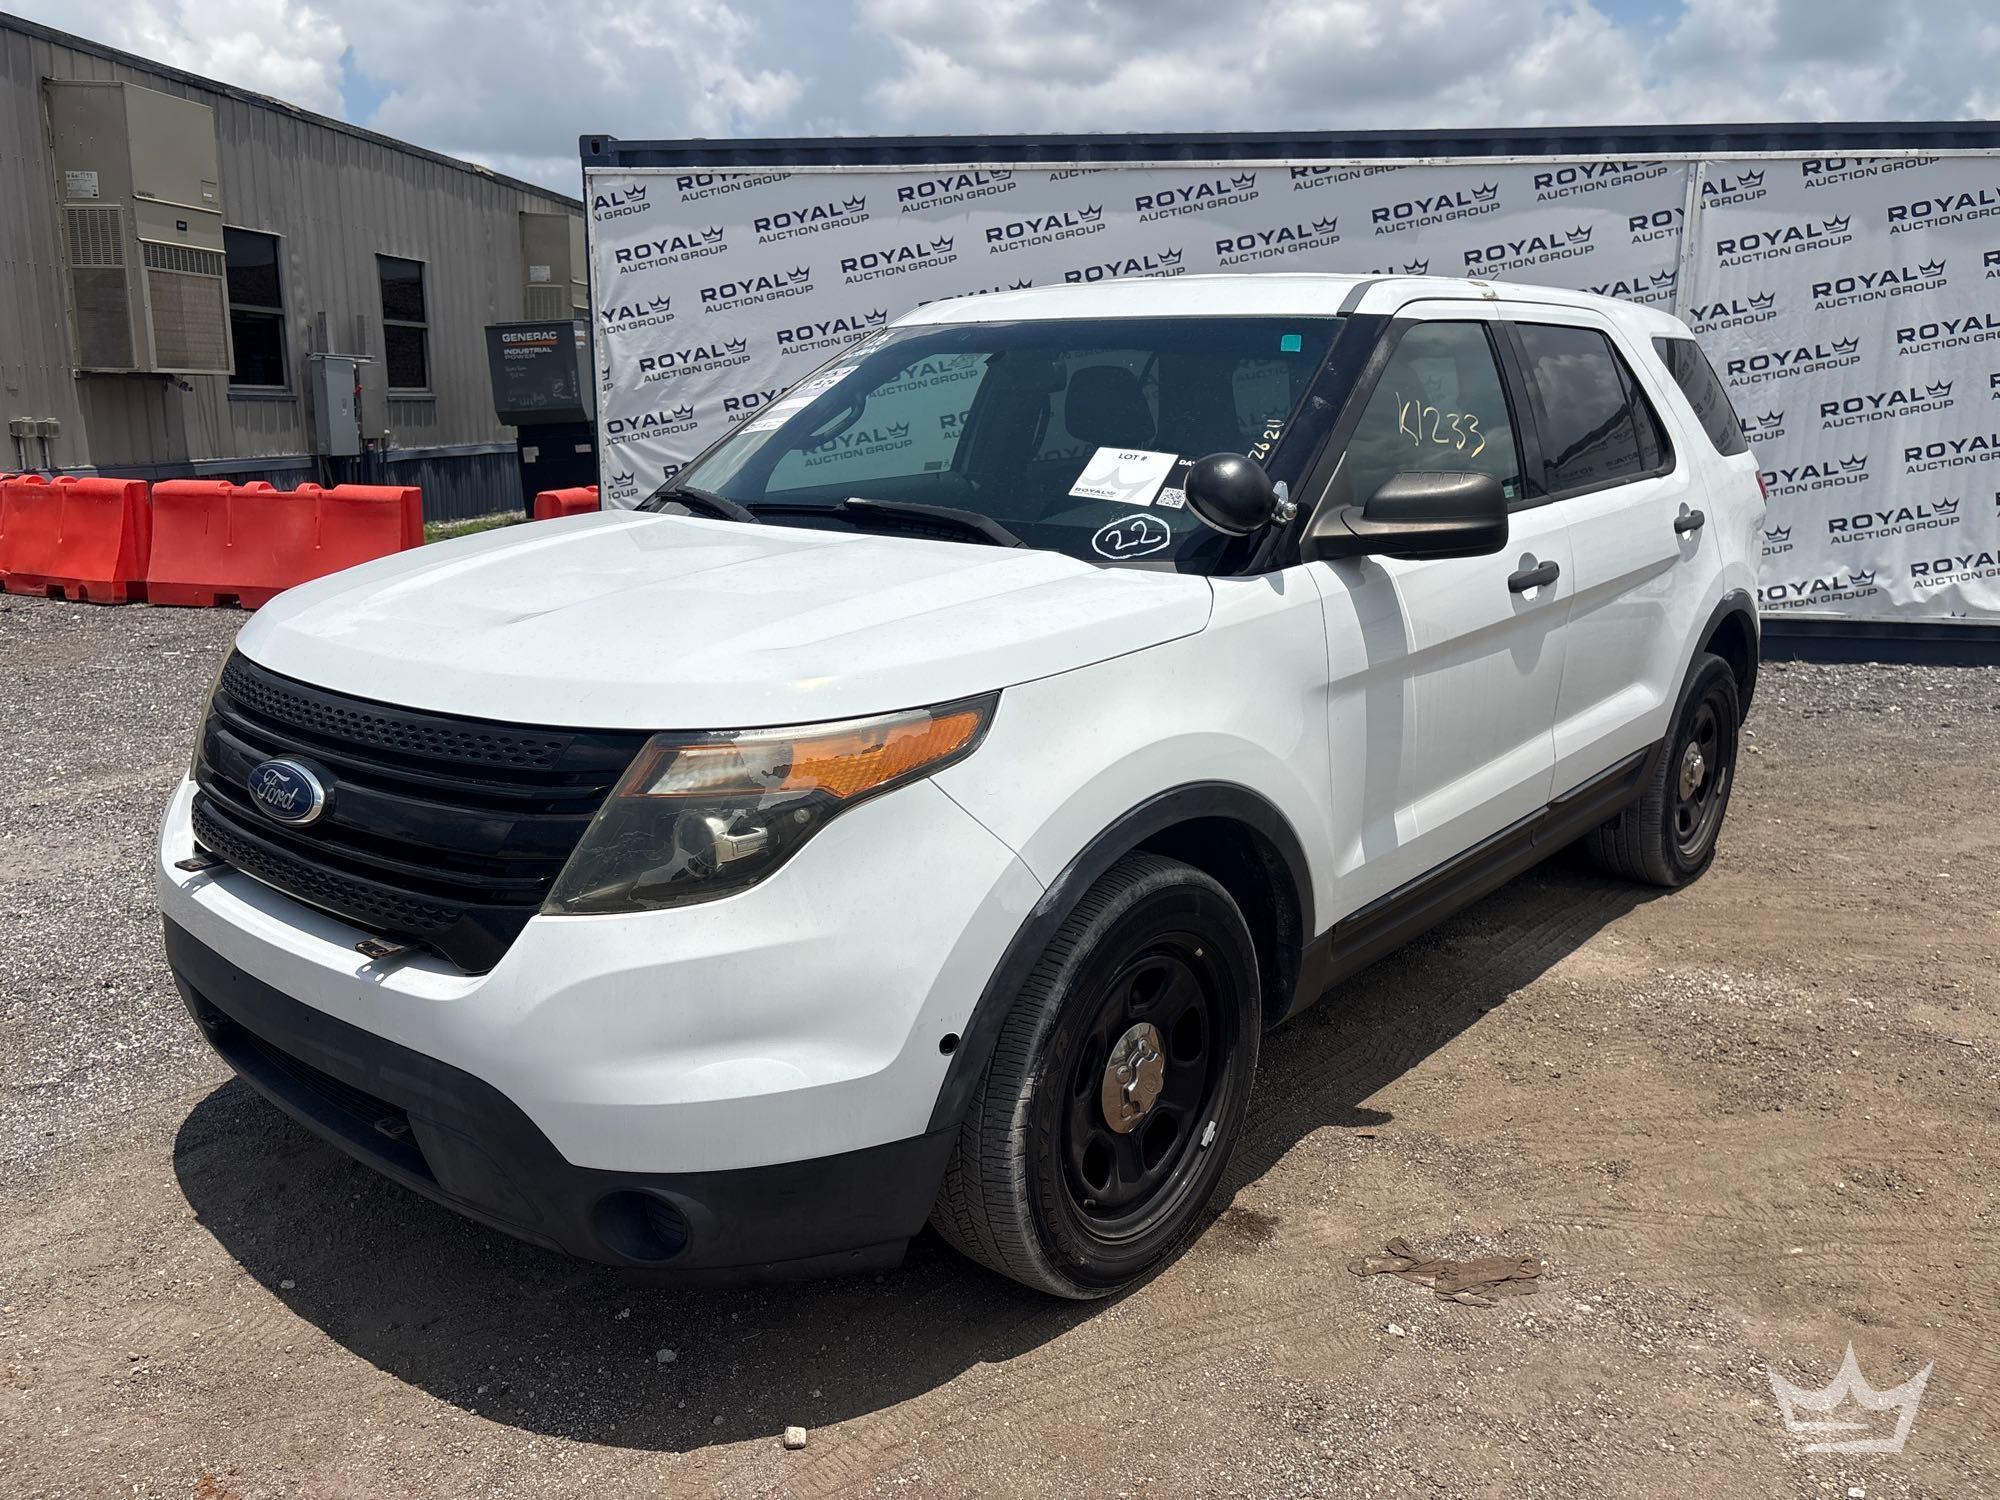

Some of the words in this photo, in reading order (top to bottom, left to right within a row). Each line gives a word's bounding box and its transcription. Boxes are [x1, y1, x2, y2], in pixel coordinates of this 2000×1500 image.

[681, 183, 741, 202] AUCTION
[897, 171, 989, 202] ROYAL
[1293, 170, 1361, 191] AUCTION
[1536, 180, 1608, 201] AUCTION
[1611, 167, 1668, 187] GROUP
[1804, 168, 1878, 189] AUCTION
[901, 193, 964, 213] AUCTION
[967, 182, 1016, 199] GROUP
[1135, 181, 1230, 211] ROYAL
[1139, 203, 1203, 223] AUCTION
[1207, 192, 1259, 209] GROUP
[1372, 191, 1471, 223] ROYAL
[1710, 190, 1767, 209] GROUP
[1887, 190, 1995, 222] ROYAL
[605, 203, 650, 220] GROUP
[754, 203, 843, 233] ROYAL
[1374, 214, 1442, 236] AUCTION
[1446, 202, 1500, 220] GROUP
[1890, 214, 1963, 235] AUCTION
[1966, 206, 2000, 220] GRO
[758, 224, 819, 244] AUCTION
[821, 214, 870, 230] GROUP
[986, 213, 1079, 242] ROYAL
[989, 234, 1052, 254] AUCTION
[1055, 224, 1106, 240] GROUP
[1216, 225, 1312, 255] ROYAL
[1632, 226, 1683, 244] AUCTI
[1717, 224, 1822, 255] ROYAL
[615, 234, 702, 263] ROYAL
[620, 255, 678, 275] AUCTION
[681, 244, 728, 261] GROUP
[840, 244, 930, 273] ROYAL
[1219, 247, 1284, 267] AUCTION
[1288, 236, 1340, 253] GROUP
[1463, 234, 1565, 266] ROYAL
[1467, 257, 1536, 278] AUCTION
[1539, 245, 1594, 262] GROUP
[1719, 246, 1792, 268] AUCTION
[1794, 235, 1852, 253] GROUP
[845, 264, 906, 284] AUCTION
[908, 254, 957, 271] GROUP
[1064, 256, 1158, 283] ROYAL
[1812, 267, 1918, 298] ROYAL
[700, 274, 788, 303] ROYAL
[704, 295, 764, 314] AUCTION
[767, 285, 814, 301] GROUP
[1814, 290, 1886, 311] AUCTION
[1890, 279, 1947, 297] GROUP
[601, 303, 649, 323] YAL
[629, 314, 674, 330] GROUP
[1690, 300, 1747, 322] YAL
[1721, 311, 1777, 329] GROUP
[502, 331, 557, 342] GENERAC
[777, 317, 865, 345] ROYAL
[1897, 313, 2000, 343] ROYAL
[639, 345, 725, 372] ROYAL
[780, 338, 840, 356] AUCTION
[1727, 345, 1831, 376] ROYAL
[1899, 336, 1970, 356] AUCTION
[644, 365, 702, 383] AUCTION
[704, 355, 750, 371] GROUP
[930, 370, 978, 386] GROUP
[1730, 367, 1800, 387] AUCTION
[1804, 356, 1860, 373] GROUP
[1820, 388, 1924, 417] ROYAL
[1822, 411, 1896, 429] AUCTION
[1899, 400, 1954, 417] GROUP
[607, 412, 673, 434] OYAL
[652, 422, 698, 437] GROUP
[1746, 429, 1785, 444] ROUP
[805, 448, 864, 467] AUCTION
[866, 440, 912, 455] GROUP
[1906, 455, 1977, 474] AUCTION
[1762, 462, 1839, 486] OYAL
[1811, 474, 1869, 490] GROUP
[1829, 505, 1931, 533] ROYAL
[1831, 527, 1901, 545] AUCTION
[1905, 517, 1960, 532] GROUP
[1106, 520, 1161, 550] 22
[1911, 552, 2000, 577] ROYA
[1913, 571, 1982, 588] AUCTION
[1820, 588, 1877, 602] GROUP
[257, 769, 298, 810] Ford
